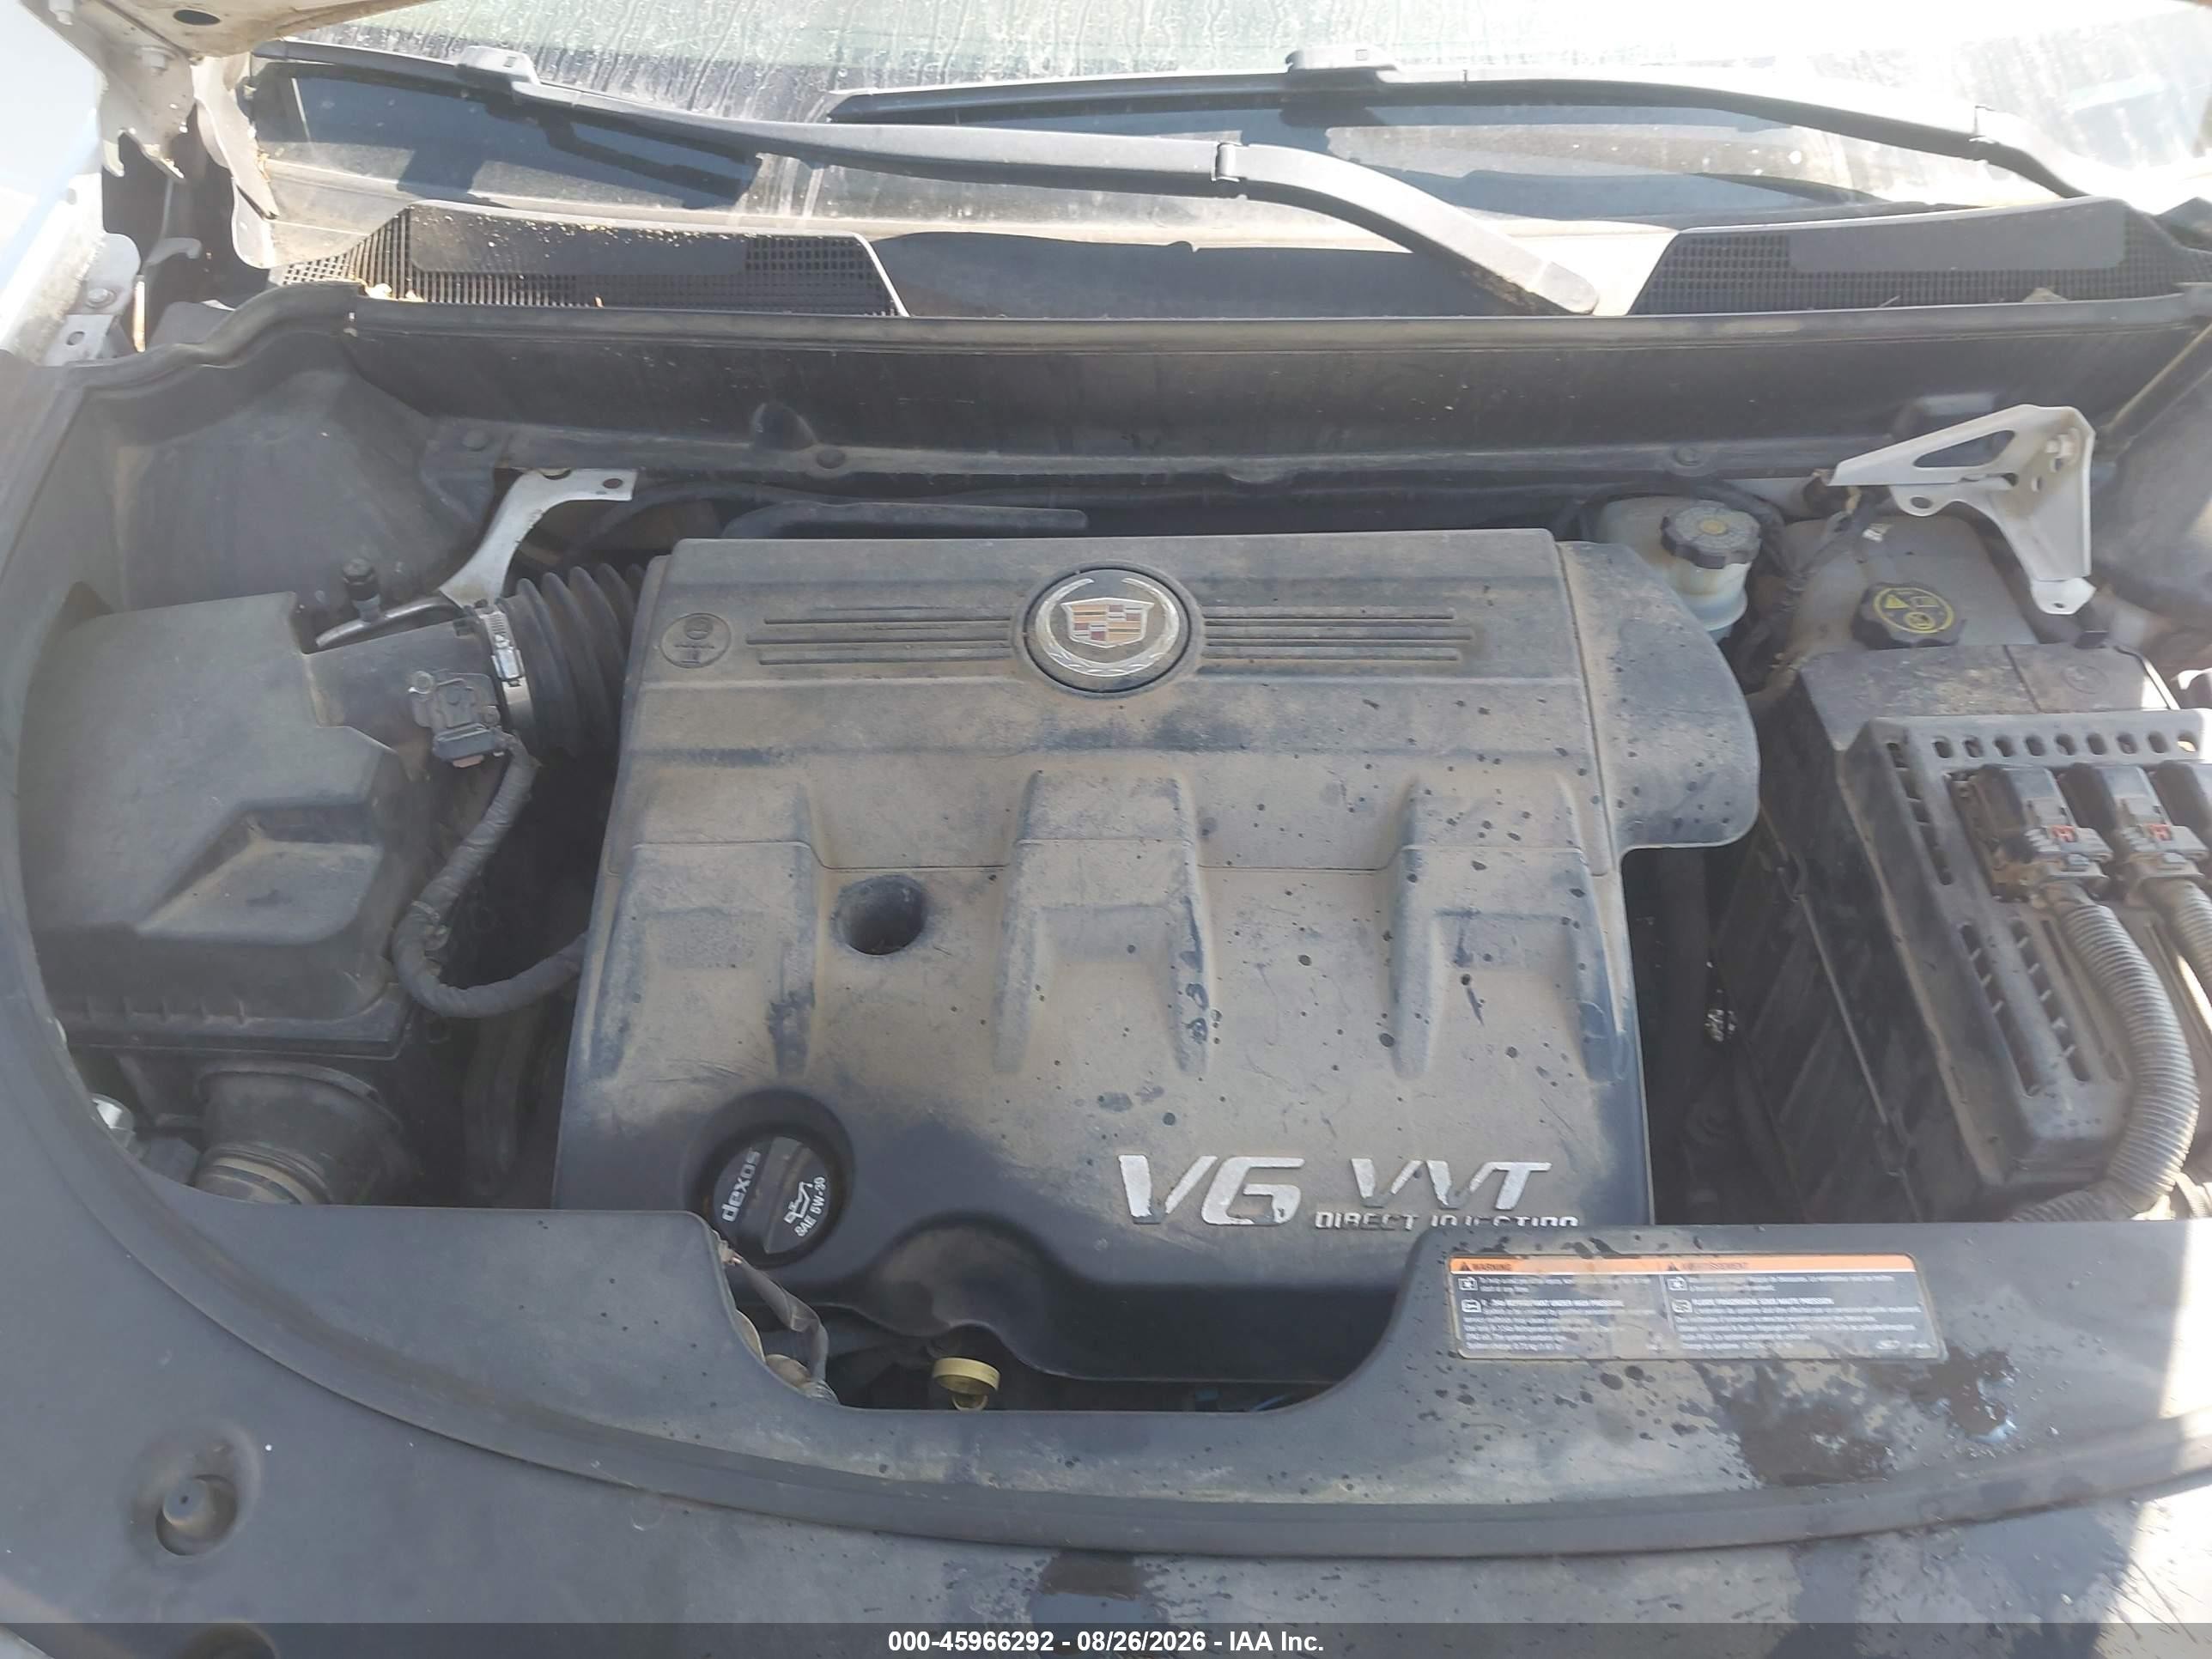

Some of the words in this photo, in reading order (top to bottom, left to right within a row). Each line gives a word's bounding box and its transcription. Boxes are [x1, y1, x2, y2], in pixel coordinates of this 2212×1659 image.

[720, 1148, 761, 1222] dexos
[1117, 1154, 1305, 1225] V6
[1350, 1158, 1553, 1209] VVT
[794, 1215, 817, 1237] SAE
[1314, 1210, 1419, 1231] DIRECT
